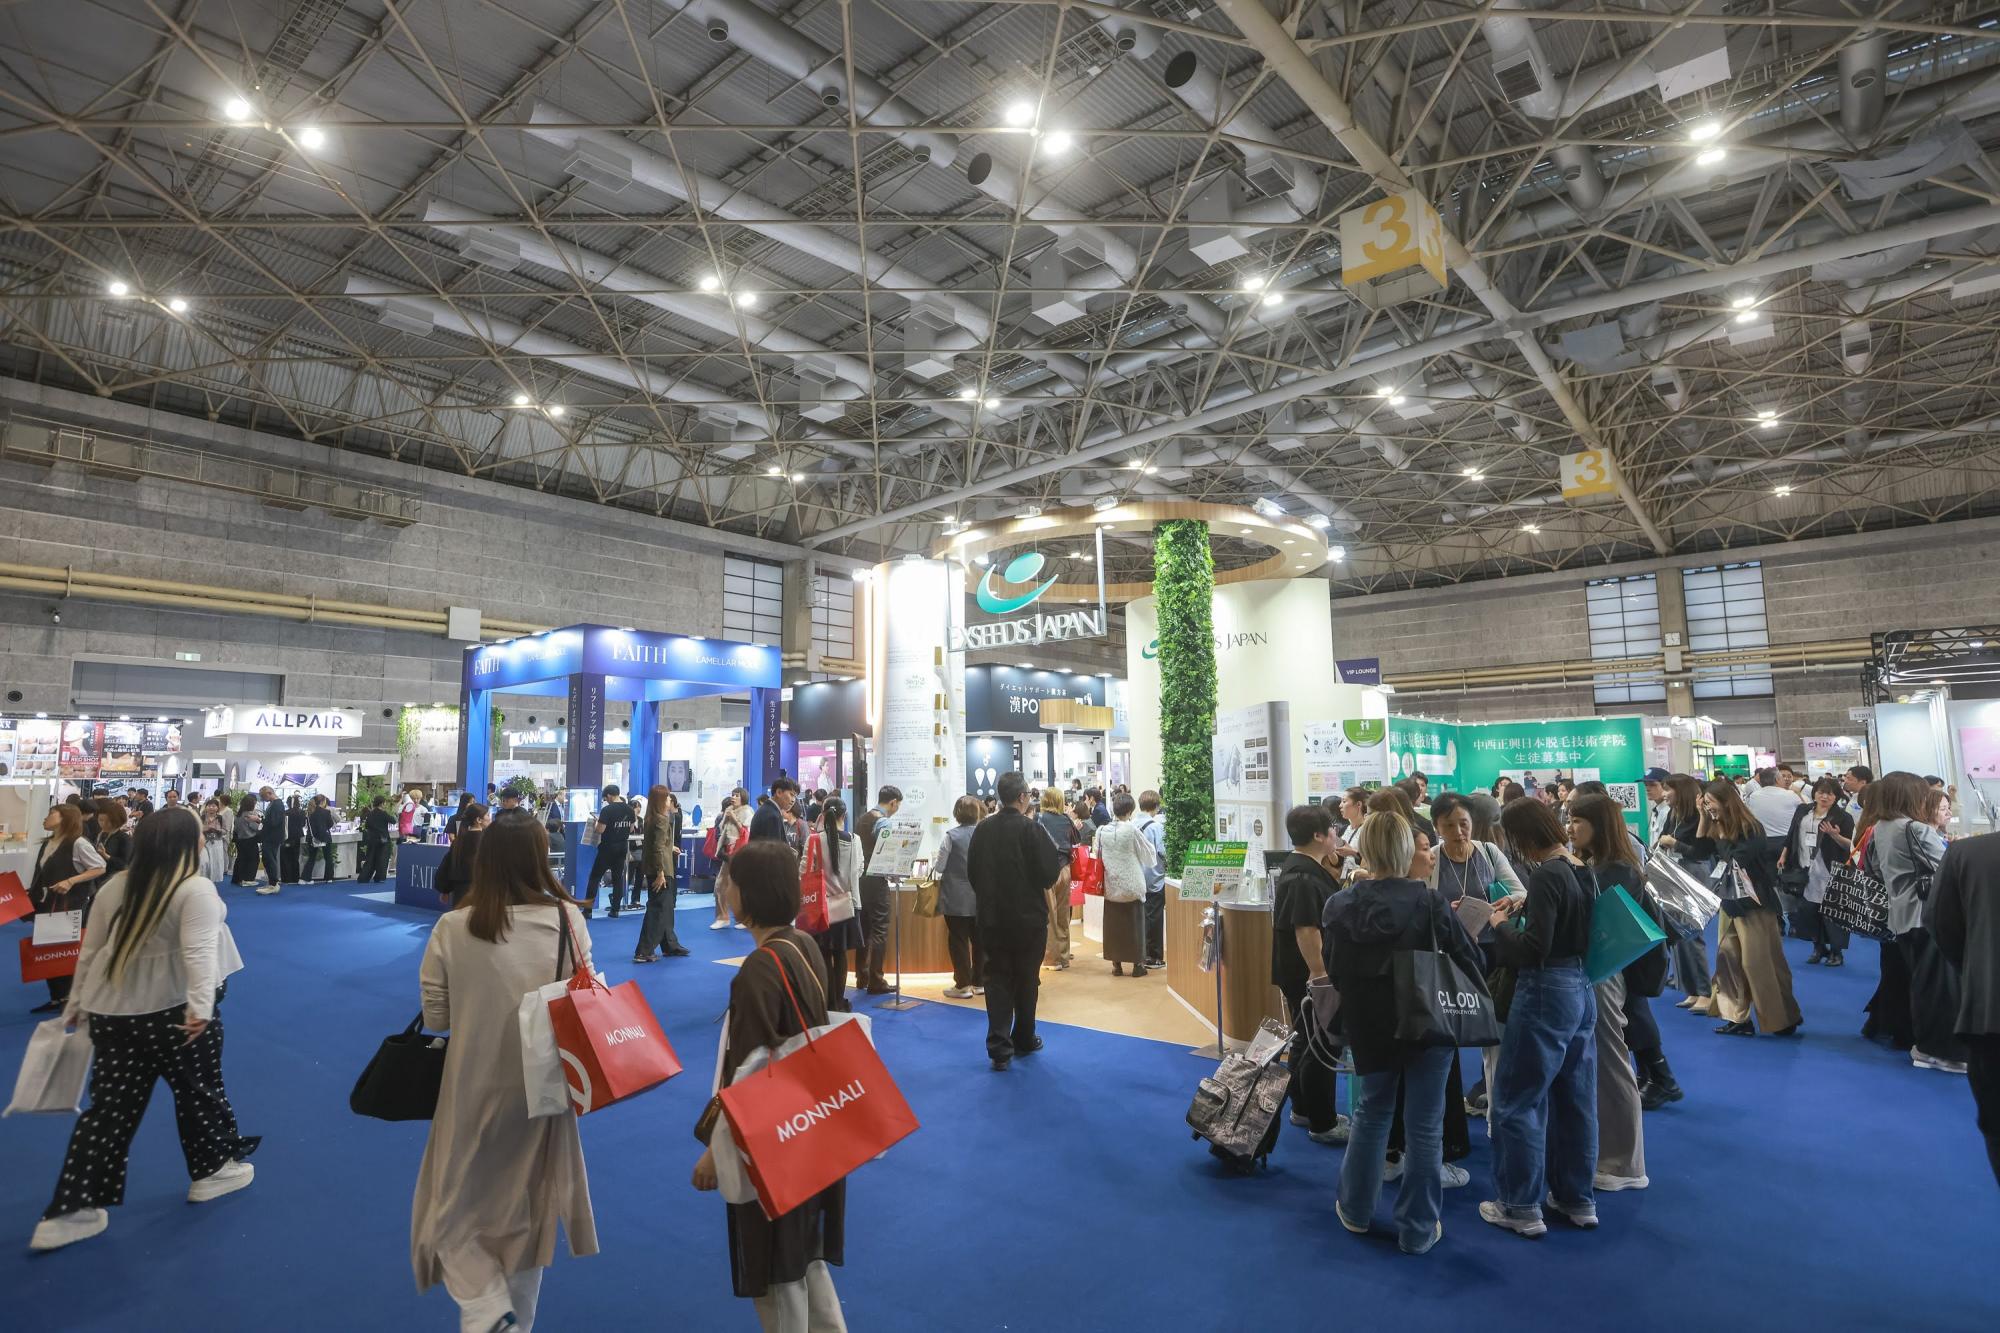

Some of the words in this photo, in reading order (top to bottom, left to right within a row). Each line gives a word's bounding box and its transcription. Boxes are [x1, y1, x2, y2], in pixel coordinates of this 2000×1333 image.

[1362, 194, 1412, 261] 3
[1574, 451, 1606, 487] 3
[948, 619, 1032, 650] EXSEEDS
[1031, 609, 1104, 646] JAPAN
[1226, 632, 1267, 650] JAPAN
[612, 645, 668, 664] FAITH
[696, 656, 737, 667] LAMELLAR
[474, 655, 501, 676] FAITH
[1355, 667, 1377, 675] LOUNGE
[1009, 695, 1041, 714] 漢PO
[256, 713, 343, 729] ALLPAIR
[1474, 734, 1626, 750] 中西正興日本脱毛技術学院
[1515, 752, 1581, 764] 生徒募集中
[1196, 843, 1224, 854] LINE
[35, 949, 80, 962] MONNALI
[1438, 991, 1480, 1008] CLODI
[776, 1079, 865, 1142] MONNALI
